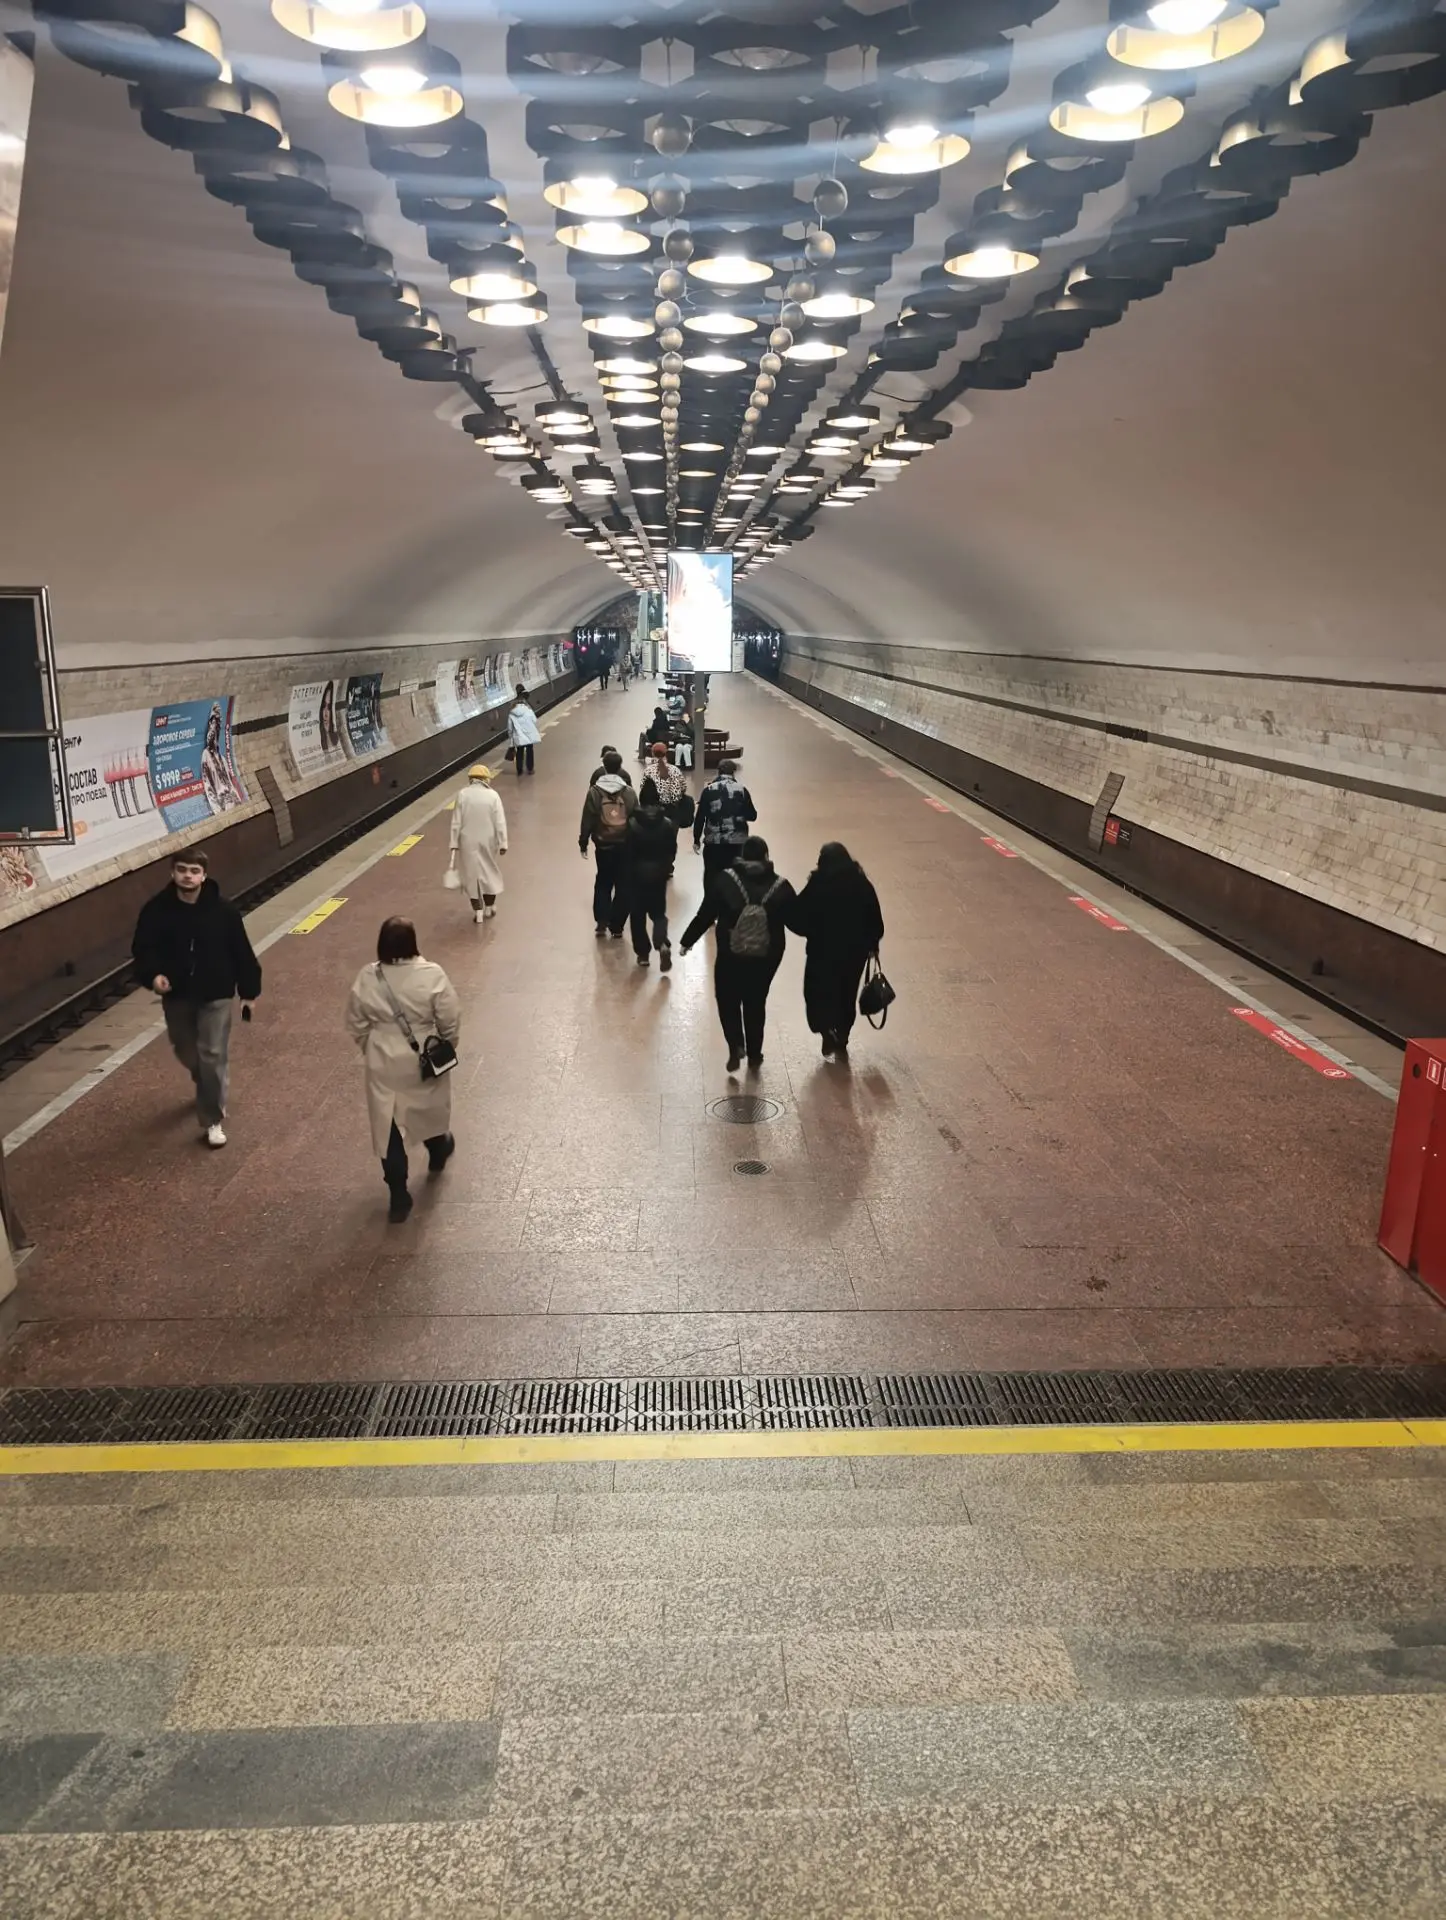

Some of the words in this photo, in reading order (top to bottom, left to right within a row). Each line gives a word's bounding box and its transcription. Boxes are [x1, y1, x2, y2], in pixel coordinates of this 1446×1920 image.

[68, 768, 98, 791] СОСТАВ
[71, 793, 86, 807] ПРО
[85, 787, 108, 803] ПОЕЗД
